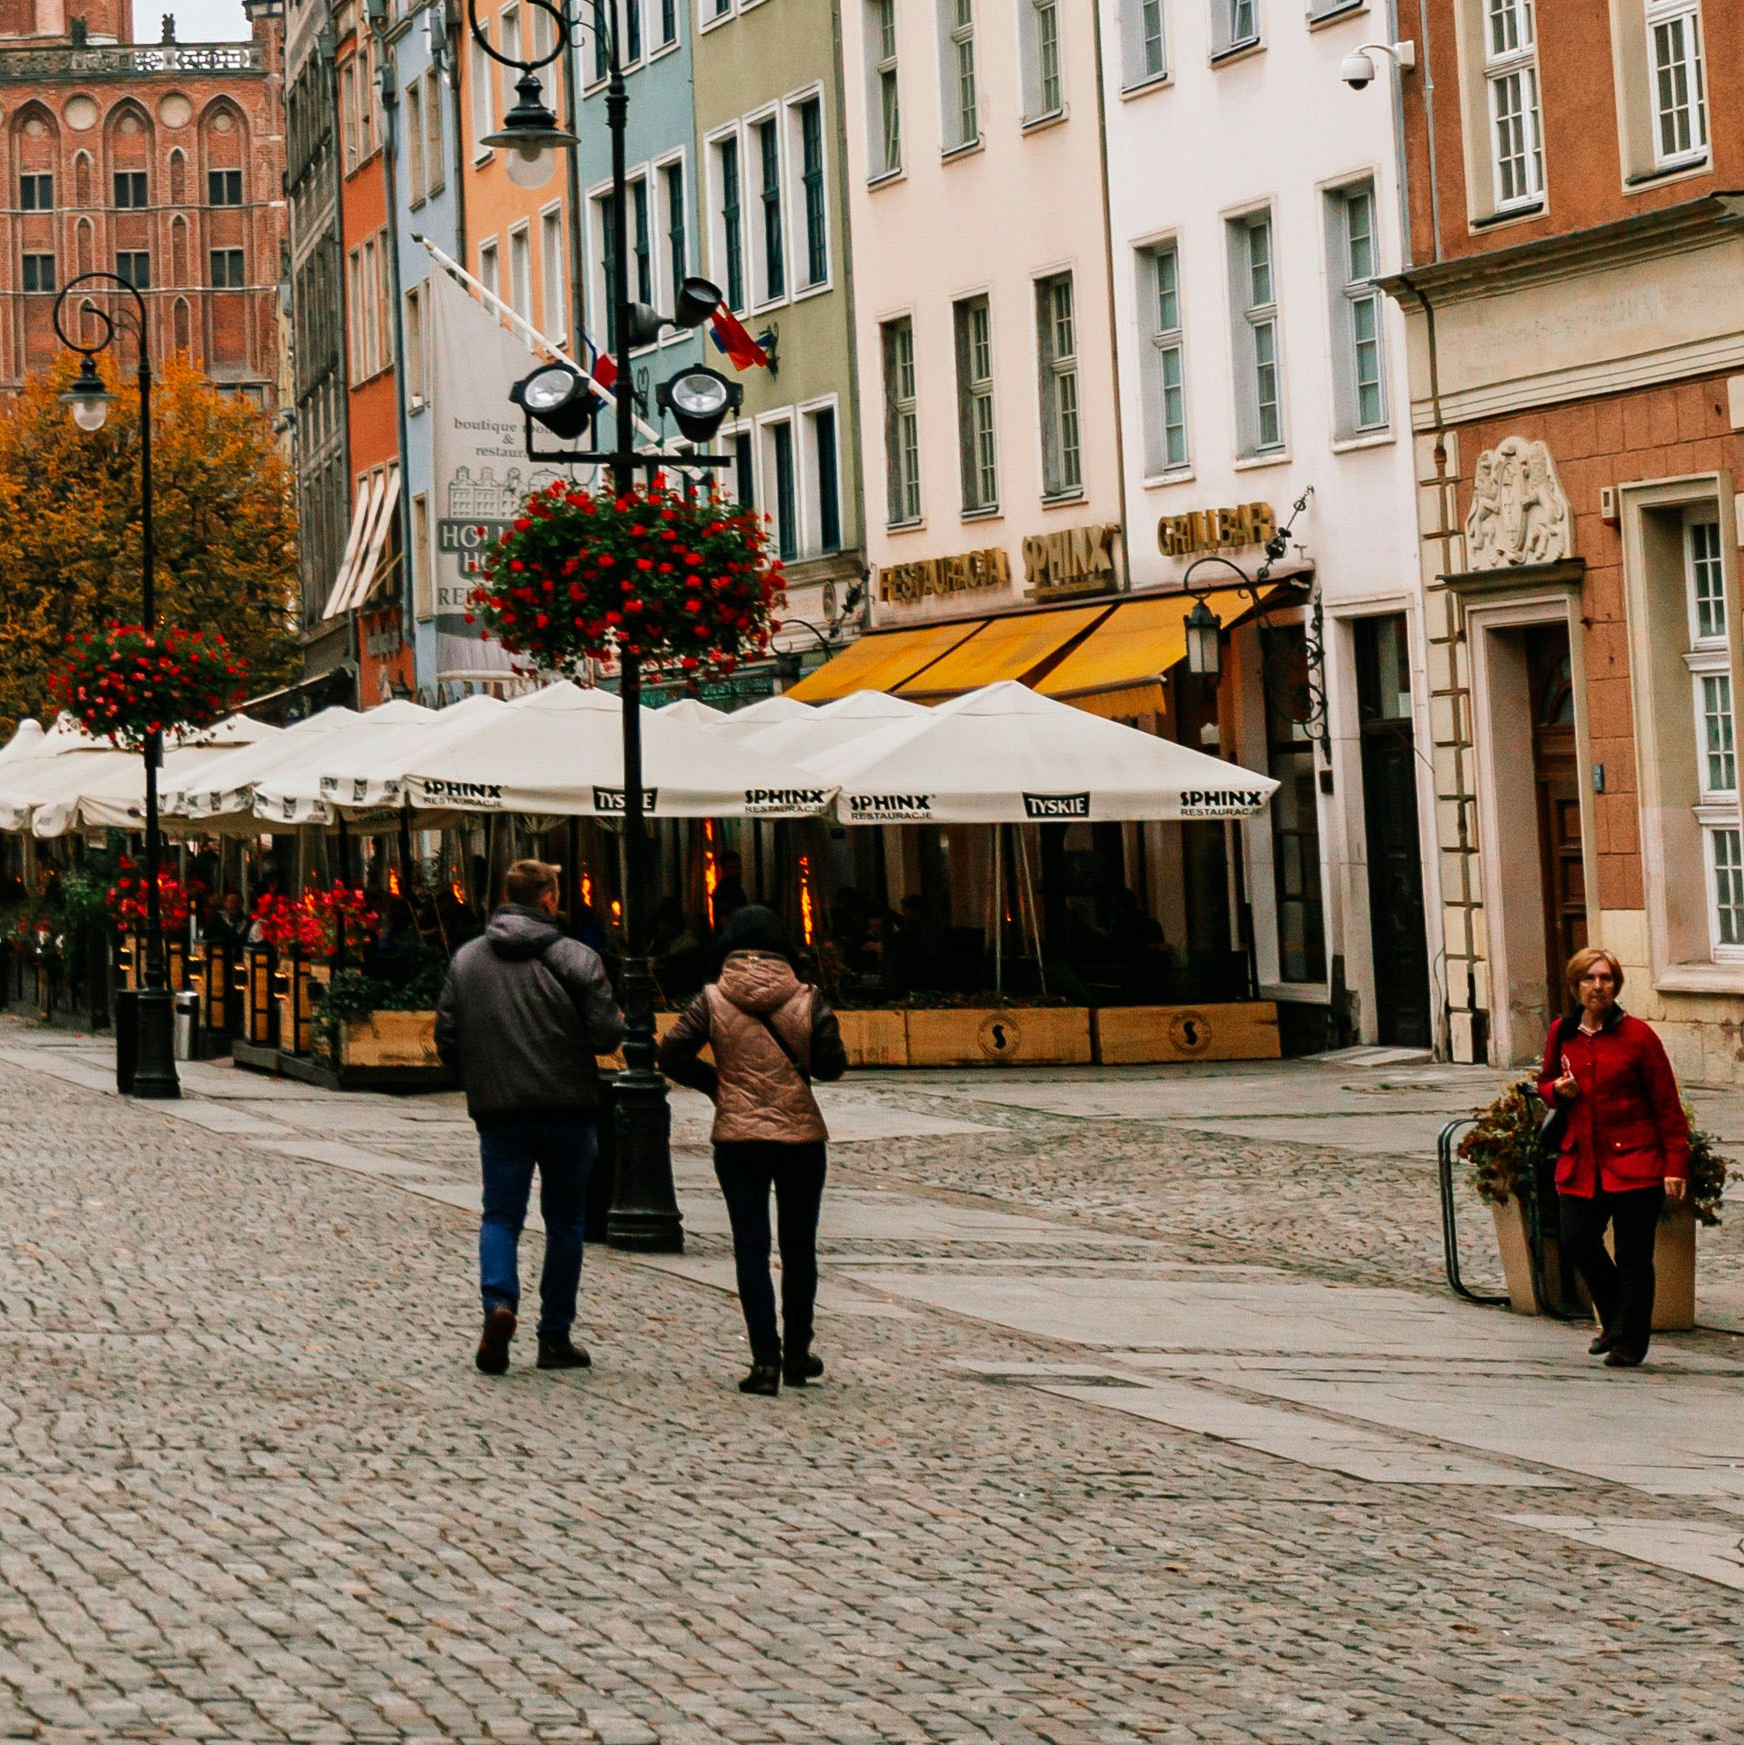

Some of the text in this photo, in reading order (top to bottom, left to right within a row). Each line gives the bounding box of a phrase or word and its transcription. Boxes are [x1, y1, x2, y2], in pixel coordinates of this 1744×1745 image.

[454, 418, 517, 434] boutique
[502, 434, 514, 445] &
[475, 445, 528, 458] restaur
[1217, 502, 1276, 548] BAR
[1022, 525, 1112, 583] SPHINX
[424, 780, 502, 799] SPHINX
[745, 789, 824, 804] SPHINX
[596, 791, 654, 809] TYSE
[850, 794, 931, 810] SPHINX
[1027, 797, 1086, 815] TYSKIE
[1180, 791, 1262, 807] SPHINX
[745, 806, 826, 815] RESTAURACJE
[851, 812, 933, 821] RESTAURACJE
